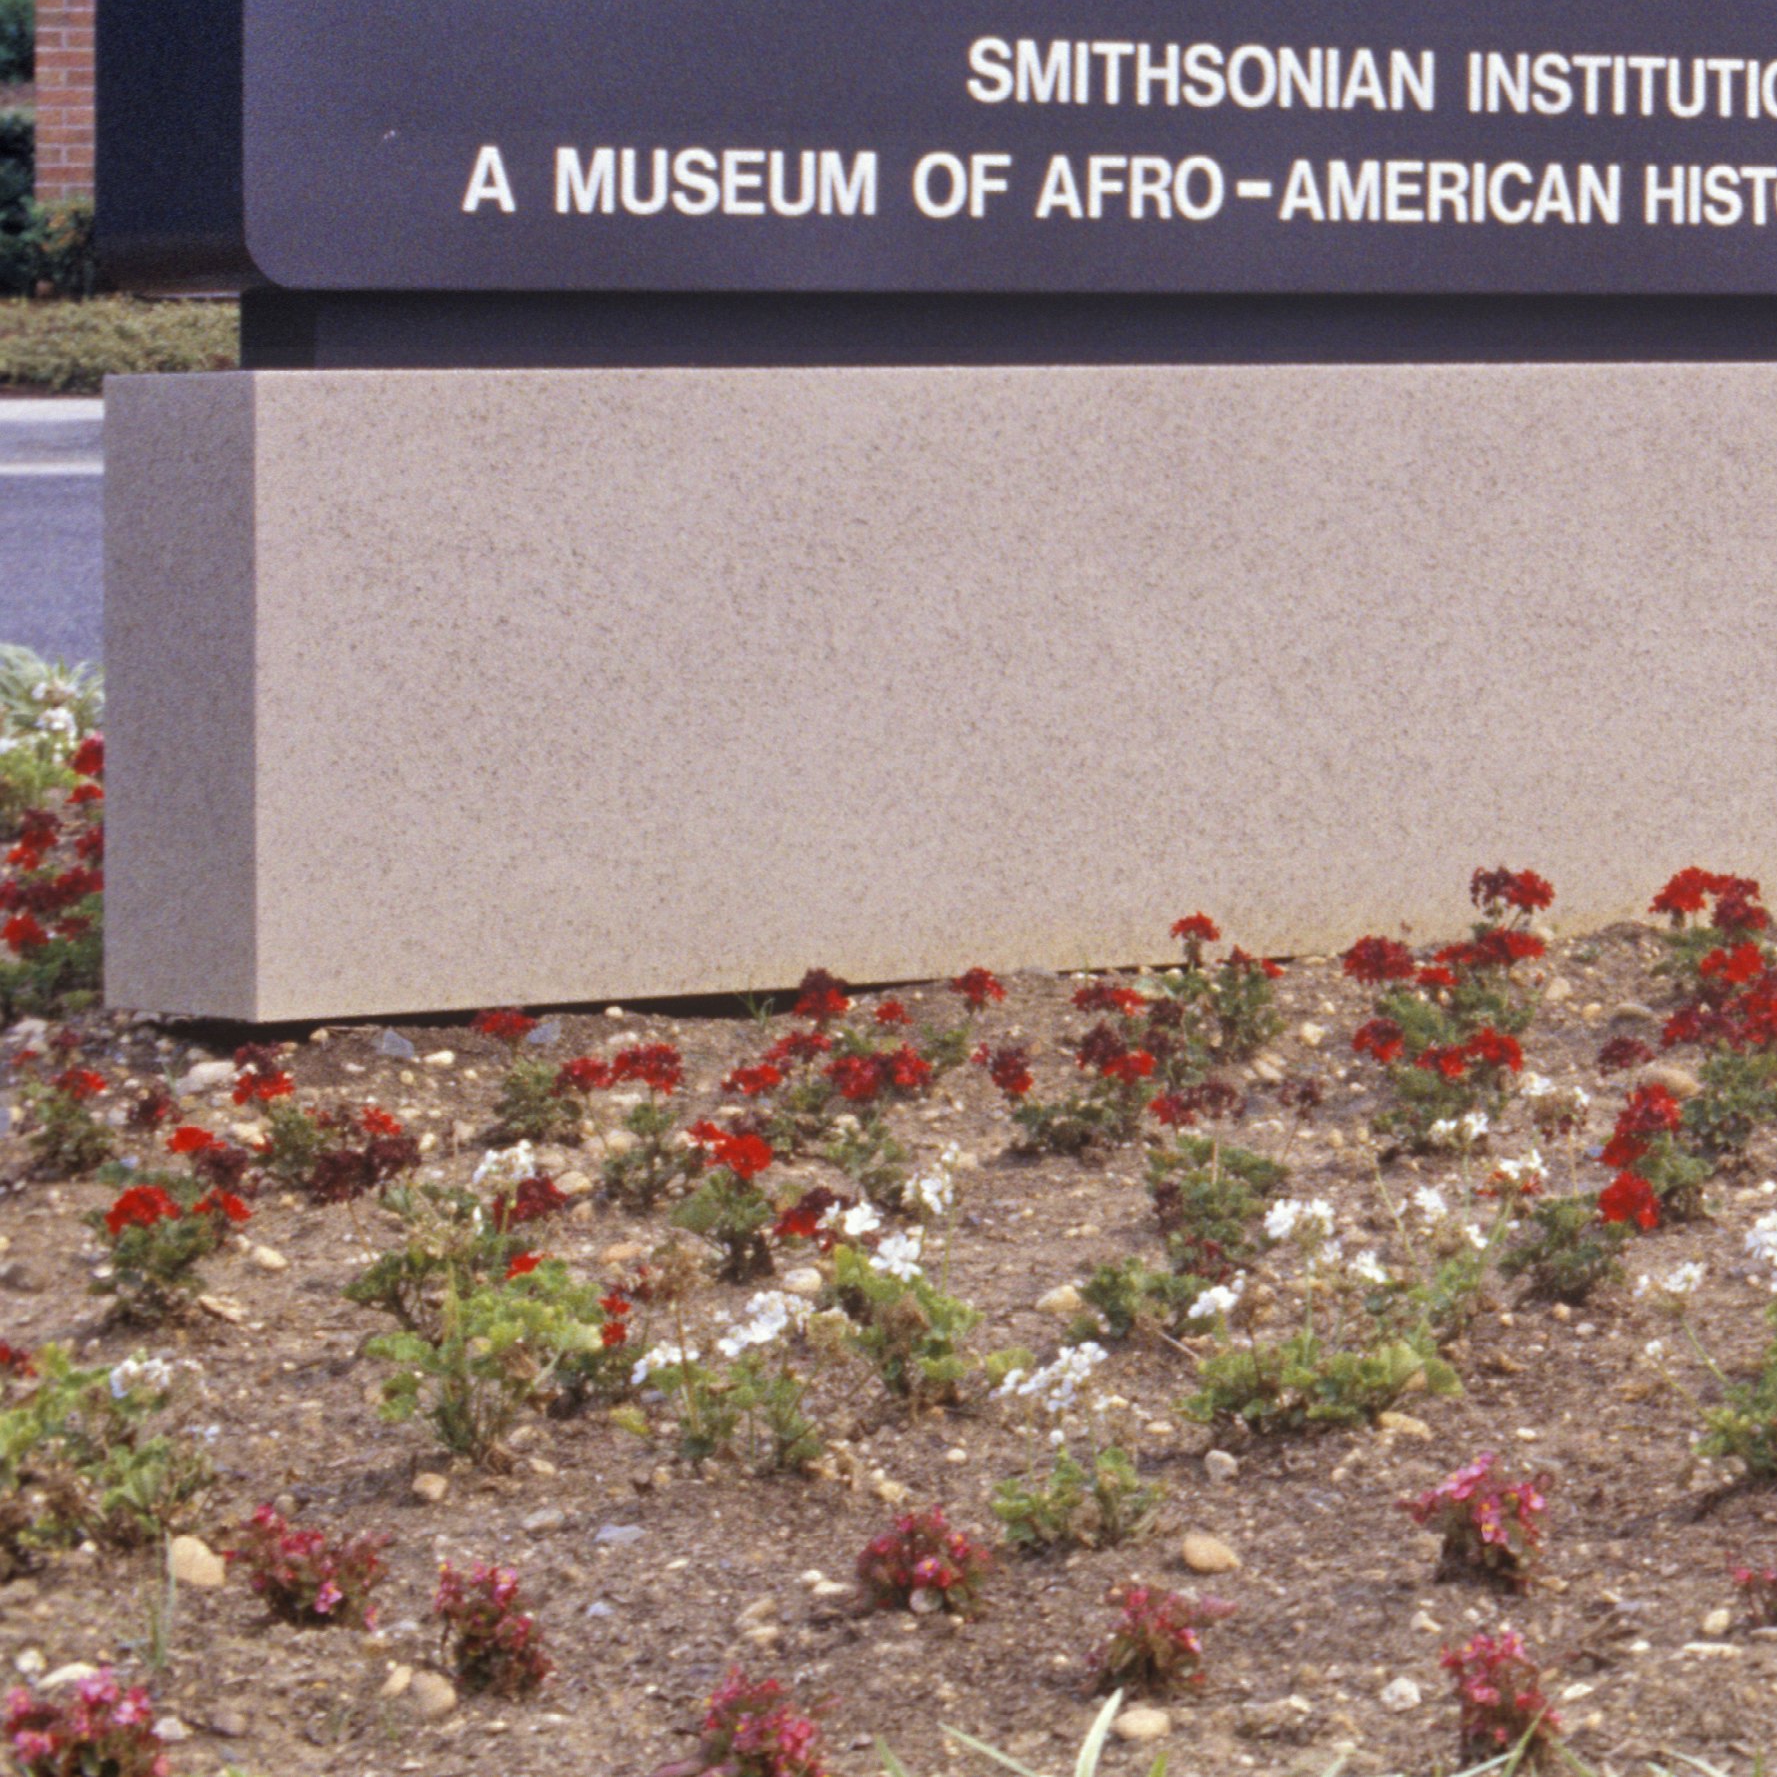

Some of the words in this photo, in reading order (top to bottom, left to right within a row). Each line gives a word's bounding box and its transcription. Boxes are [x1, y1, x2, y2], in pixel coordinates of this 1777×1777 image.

[967, 37, 1436, 111] SMITHSONIAN
[462, 145, 516, 213] A
[556, 146, 877, 216] MUSEUM
[913, 151, 1012, 218] OF
[1036, 154, 1621, 224] AFRO-AMERICAN
